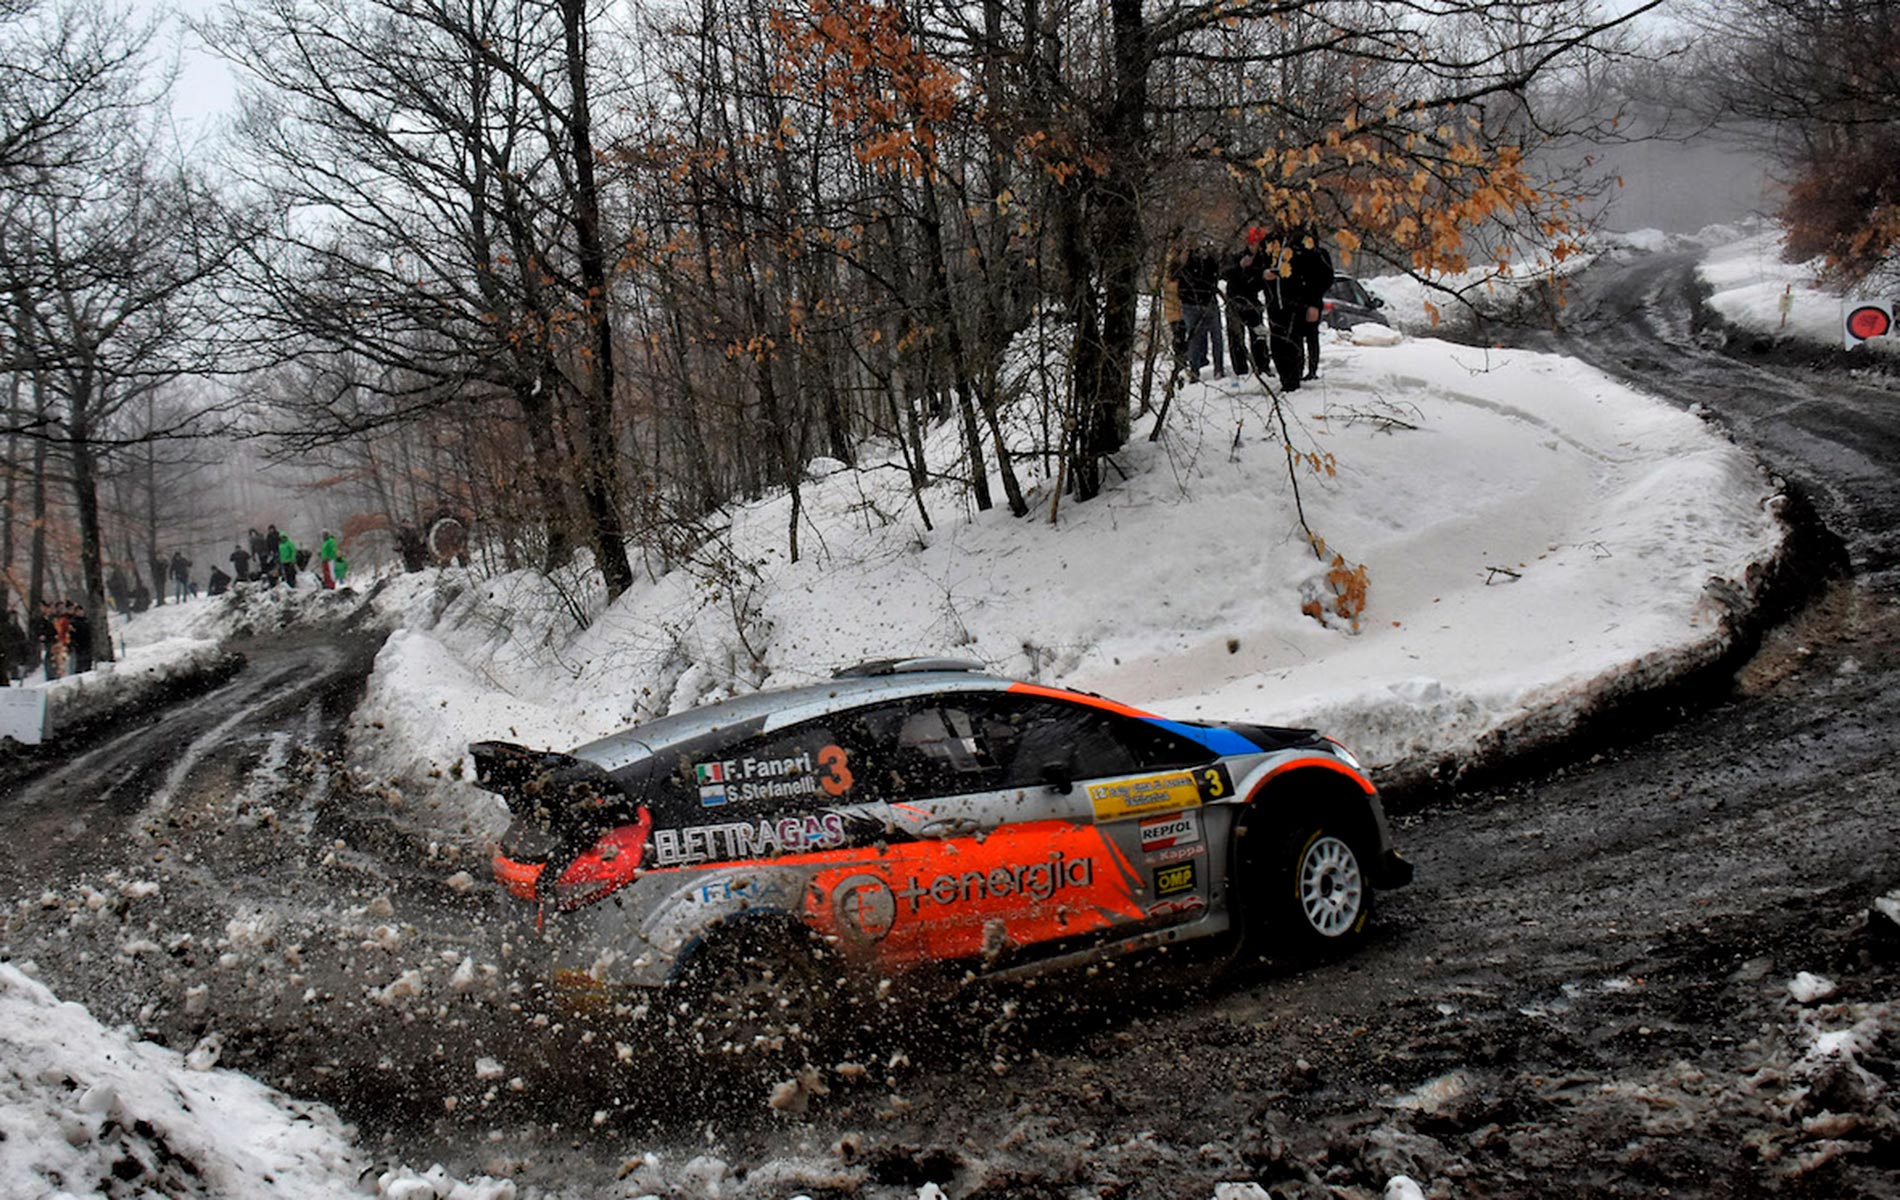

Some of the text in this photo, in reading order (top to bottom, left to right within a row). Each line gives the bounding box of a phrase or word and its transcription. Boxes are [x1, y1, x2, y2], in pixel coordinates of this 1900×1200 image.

[817, 744, 854, 796] 3
[1204, 768, 1225, 797] 3
[654, 813, 845, 865] ELETTRAGAS
[1142, 820, 1192, 840] REPSOL
[1159, 844, 1205, 862] Kappa
[1158, 870, 1193, 889] OMP
